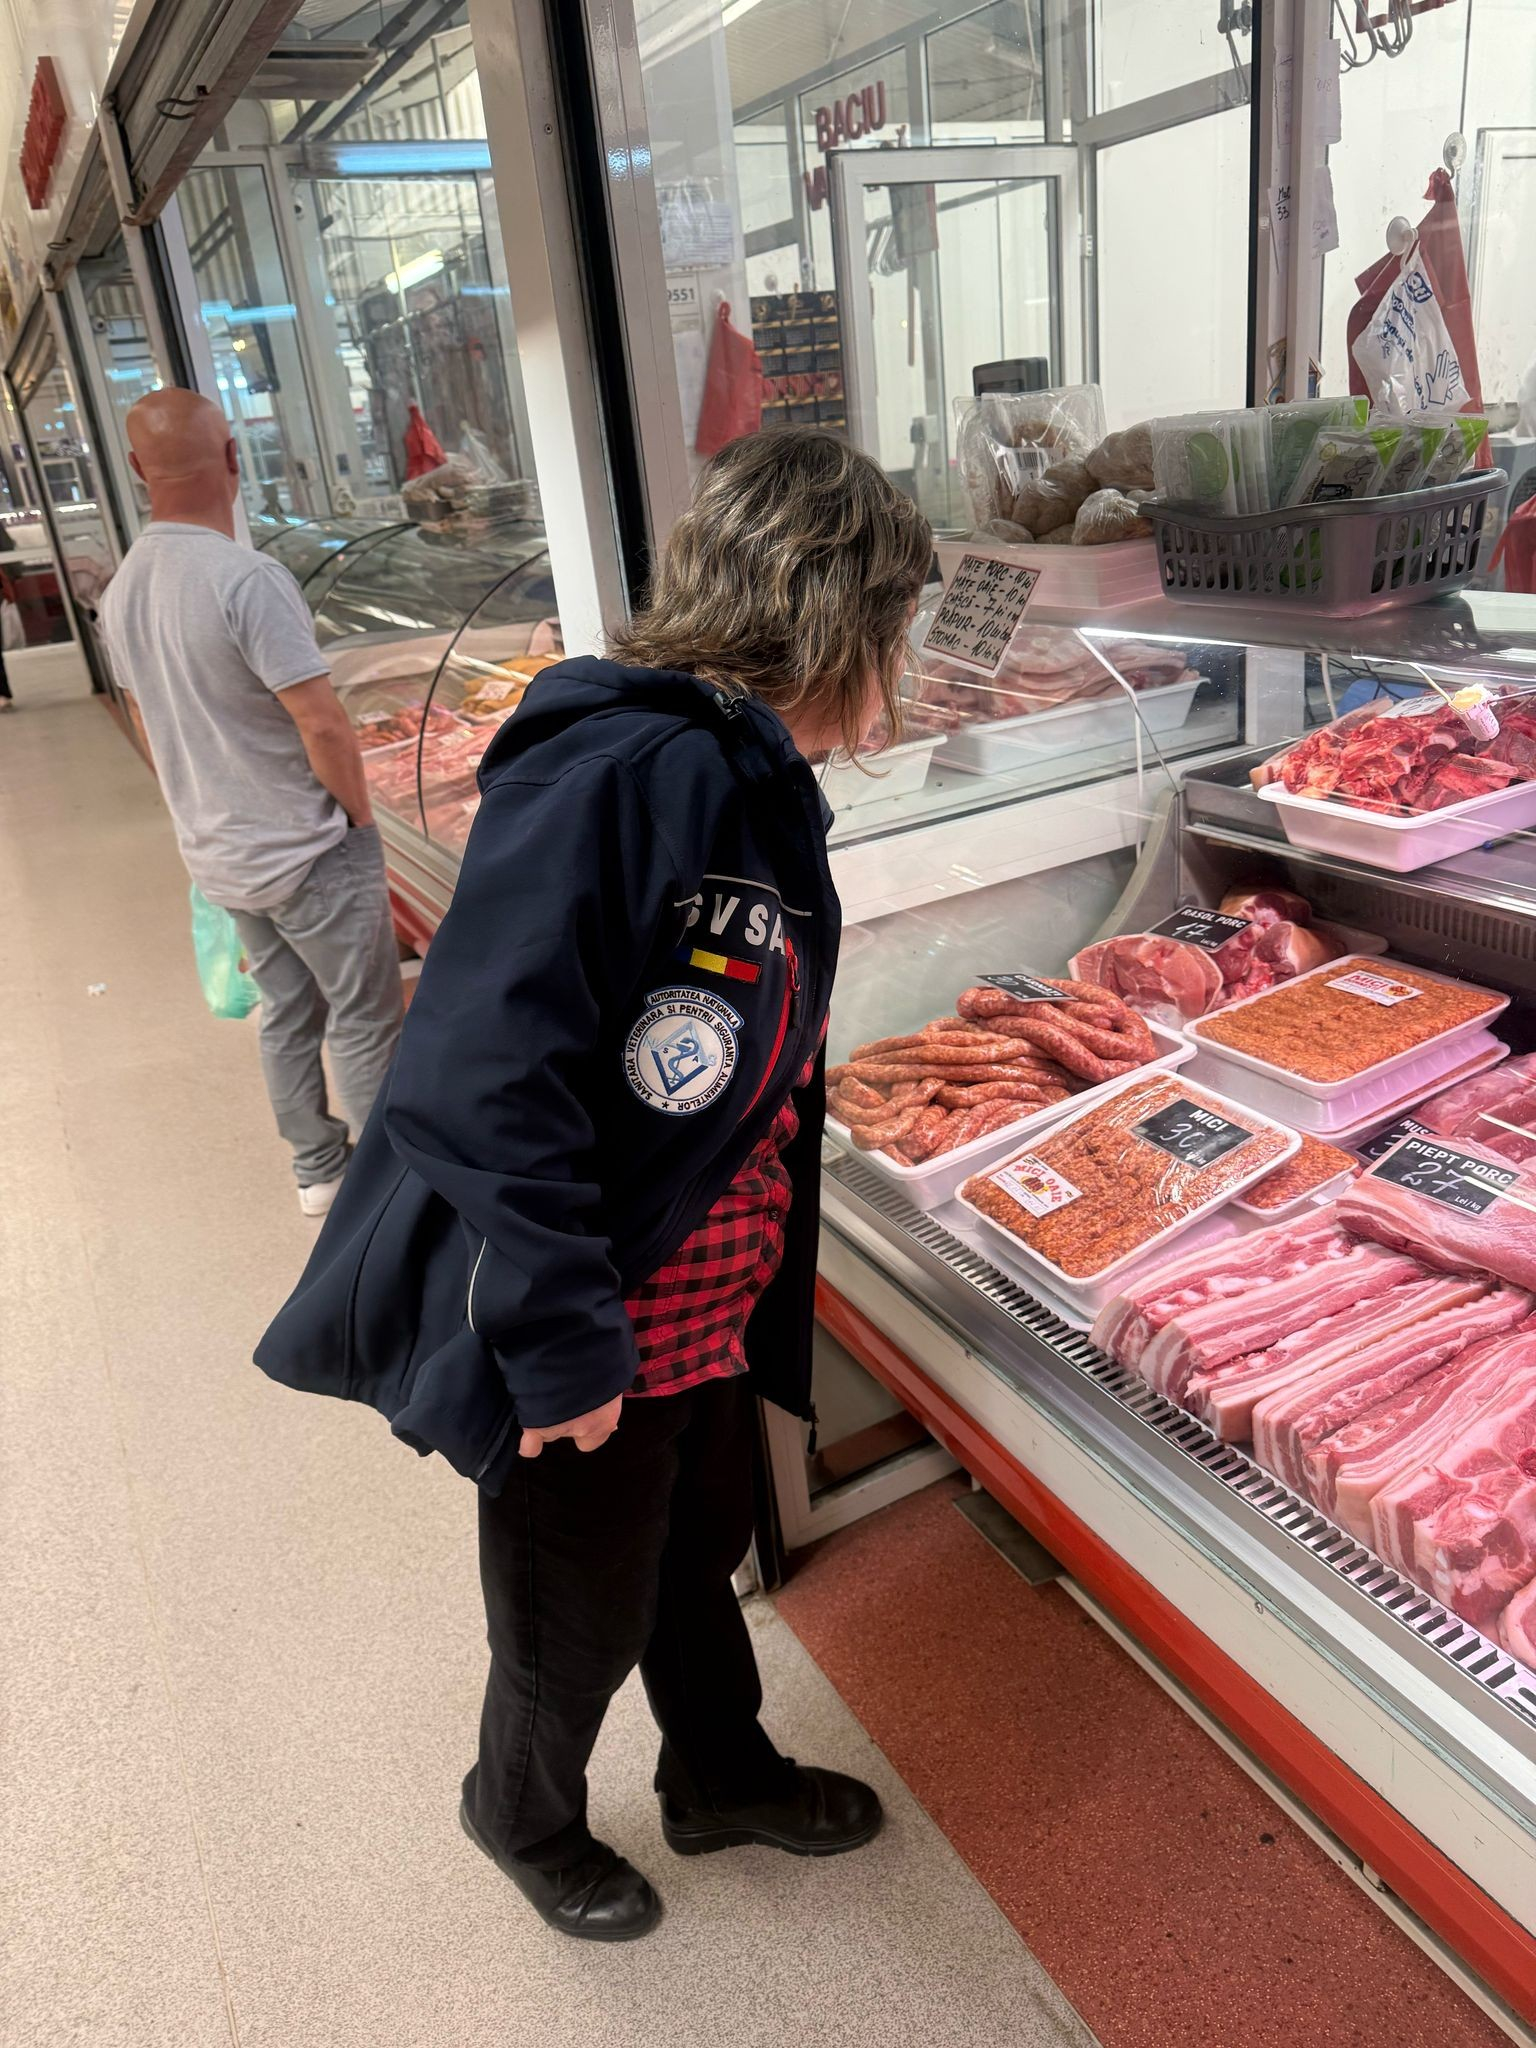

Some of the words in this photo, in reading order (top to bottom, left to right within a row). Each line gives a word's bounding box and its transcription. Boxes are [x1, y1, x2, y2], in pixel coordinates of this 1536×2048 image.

[816, 80, 886, 152] BACIU
[985, 560, 1010, 580] PORC
[984, 597, 997, 616] 7
[1005, 587, 1019, 602] 10
[928, 626, 960, 650] STOMAC
[1171, 922, 1213, 938] 17
[1180, 908, 1215, 921] RASOL
[1215, 916, 1247, 928] PORC
[650, 990, 701, 1004] AUTORITATEA
[702, 995, 739, 1028] NATIONALA
[667, 1004, 676, 1014] SI
[679, 1004, 715, 1023] PENTRU
[626, 1008, 664, 1053] VETERINARA
[714, 1021, 735, 1068] SIGURANTA
[626, 1058, 653, 1101] SANITARA
[677, 1071, 728, 1111] ALIMENTELOR
[1189, 1109, 1229, 1132] MICI
[1405, 1141, 1460, 1165] PIEPT
[1459, 1159, 1513, 1185] PORC
[1013, 1165, 1046, 1177] MICI
[1045, 1178, 1062, 1202] OAIE
[1400, 1161, 1466, 1194] 27
